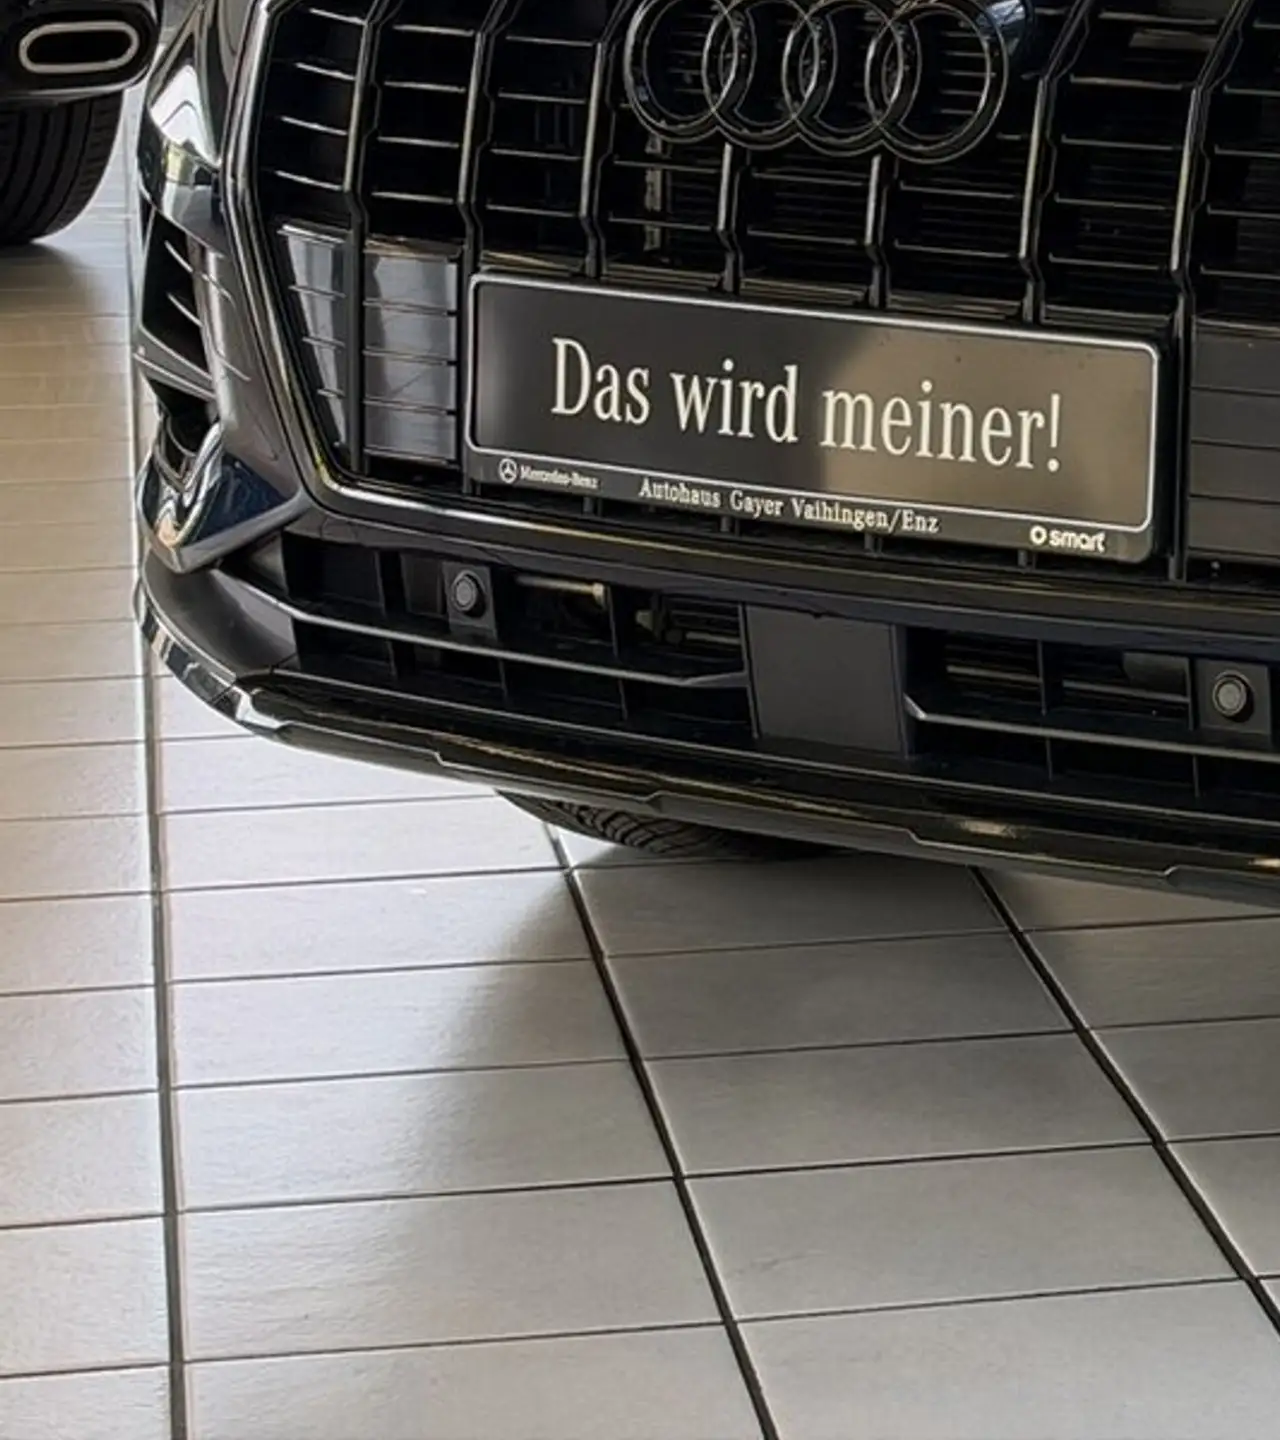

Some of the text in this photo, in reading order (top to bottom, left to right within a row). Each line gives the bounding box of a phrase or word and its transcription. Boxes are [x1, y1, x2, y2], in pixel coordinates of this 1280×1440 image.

[551, 337, 1061, 472] Das wird meiner!
[638, 476, 940, 534] Autohaus Gayer Vaihingen/Enz
[1049, 527, 1107, 553] smart
